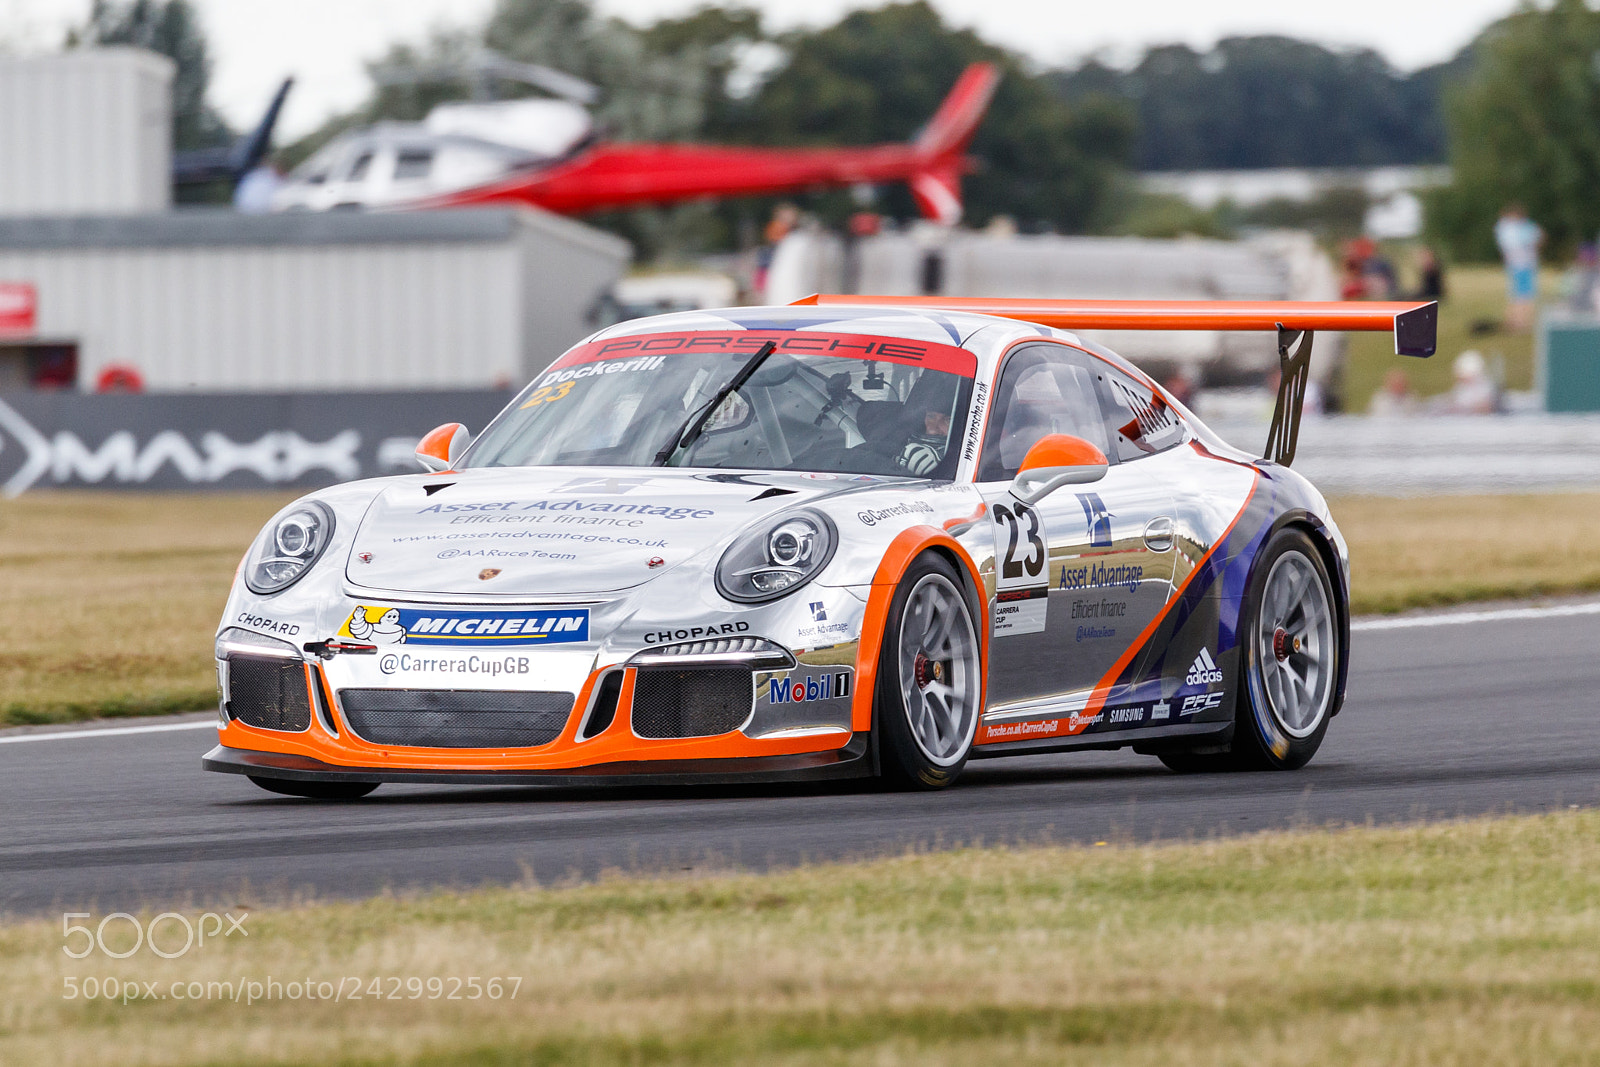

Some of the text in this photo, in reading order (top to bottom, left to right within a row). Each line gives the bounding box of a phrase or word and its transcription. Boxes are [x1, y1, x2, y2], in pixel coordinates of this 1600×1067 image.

[597, 335, 928, 361] PORSCHE
[538, 356, 666, 389] Dockerill
[519, 381, 576, 410] 23
[963, 381, 988, 462] www.porsche.co.uk
[416, 499, 715, 520] Asset Advantage
[857, 500, 935, 526] @CarreraCupGB
[449, 513, 644, 528] Efficient finance
[392, 530, 669, 550] www.assetadvantage.co.uk
[992, 501, 1045, 580] 23
[436, 548, 576, 561] @AARaceTeam
[1059, 560, 1143, 594] Asset Advantage
[996, 606, 1020, 615] CARRERA
[1071, 598, 1126, 619] Efficient finance
[237, 611, 300, 636] CHOPARD
[408, 615, 586, 635] MICHELIN
[817, 622, 848, 634] Advantage
[995, 616, 1006, 624] CUP
[643, 621, 750, 644] CHOPARD
[379, 653, 530, 677] @CarreraCupGB
[1186, 671, 1223, 686] adidas
[769, 675, 831, 704] Mobil
[1182, 691, 1224, 710] PFC
[1109, 707, 1144, 724] SAMSUNG
[986, 719, 1058, 738] Porsche.co.uk/CarreraCupGB
